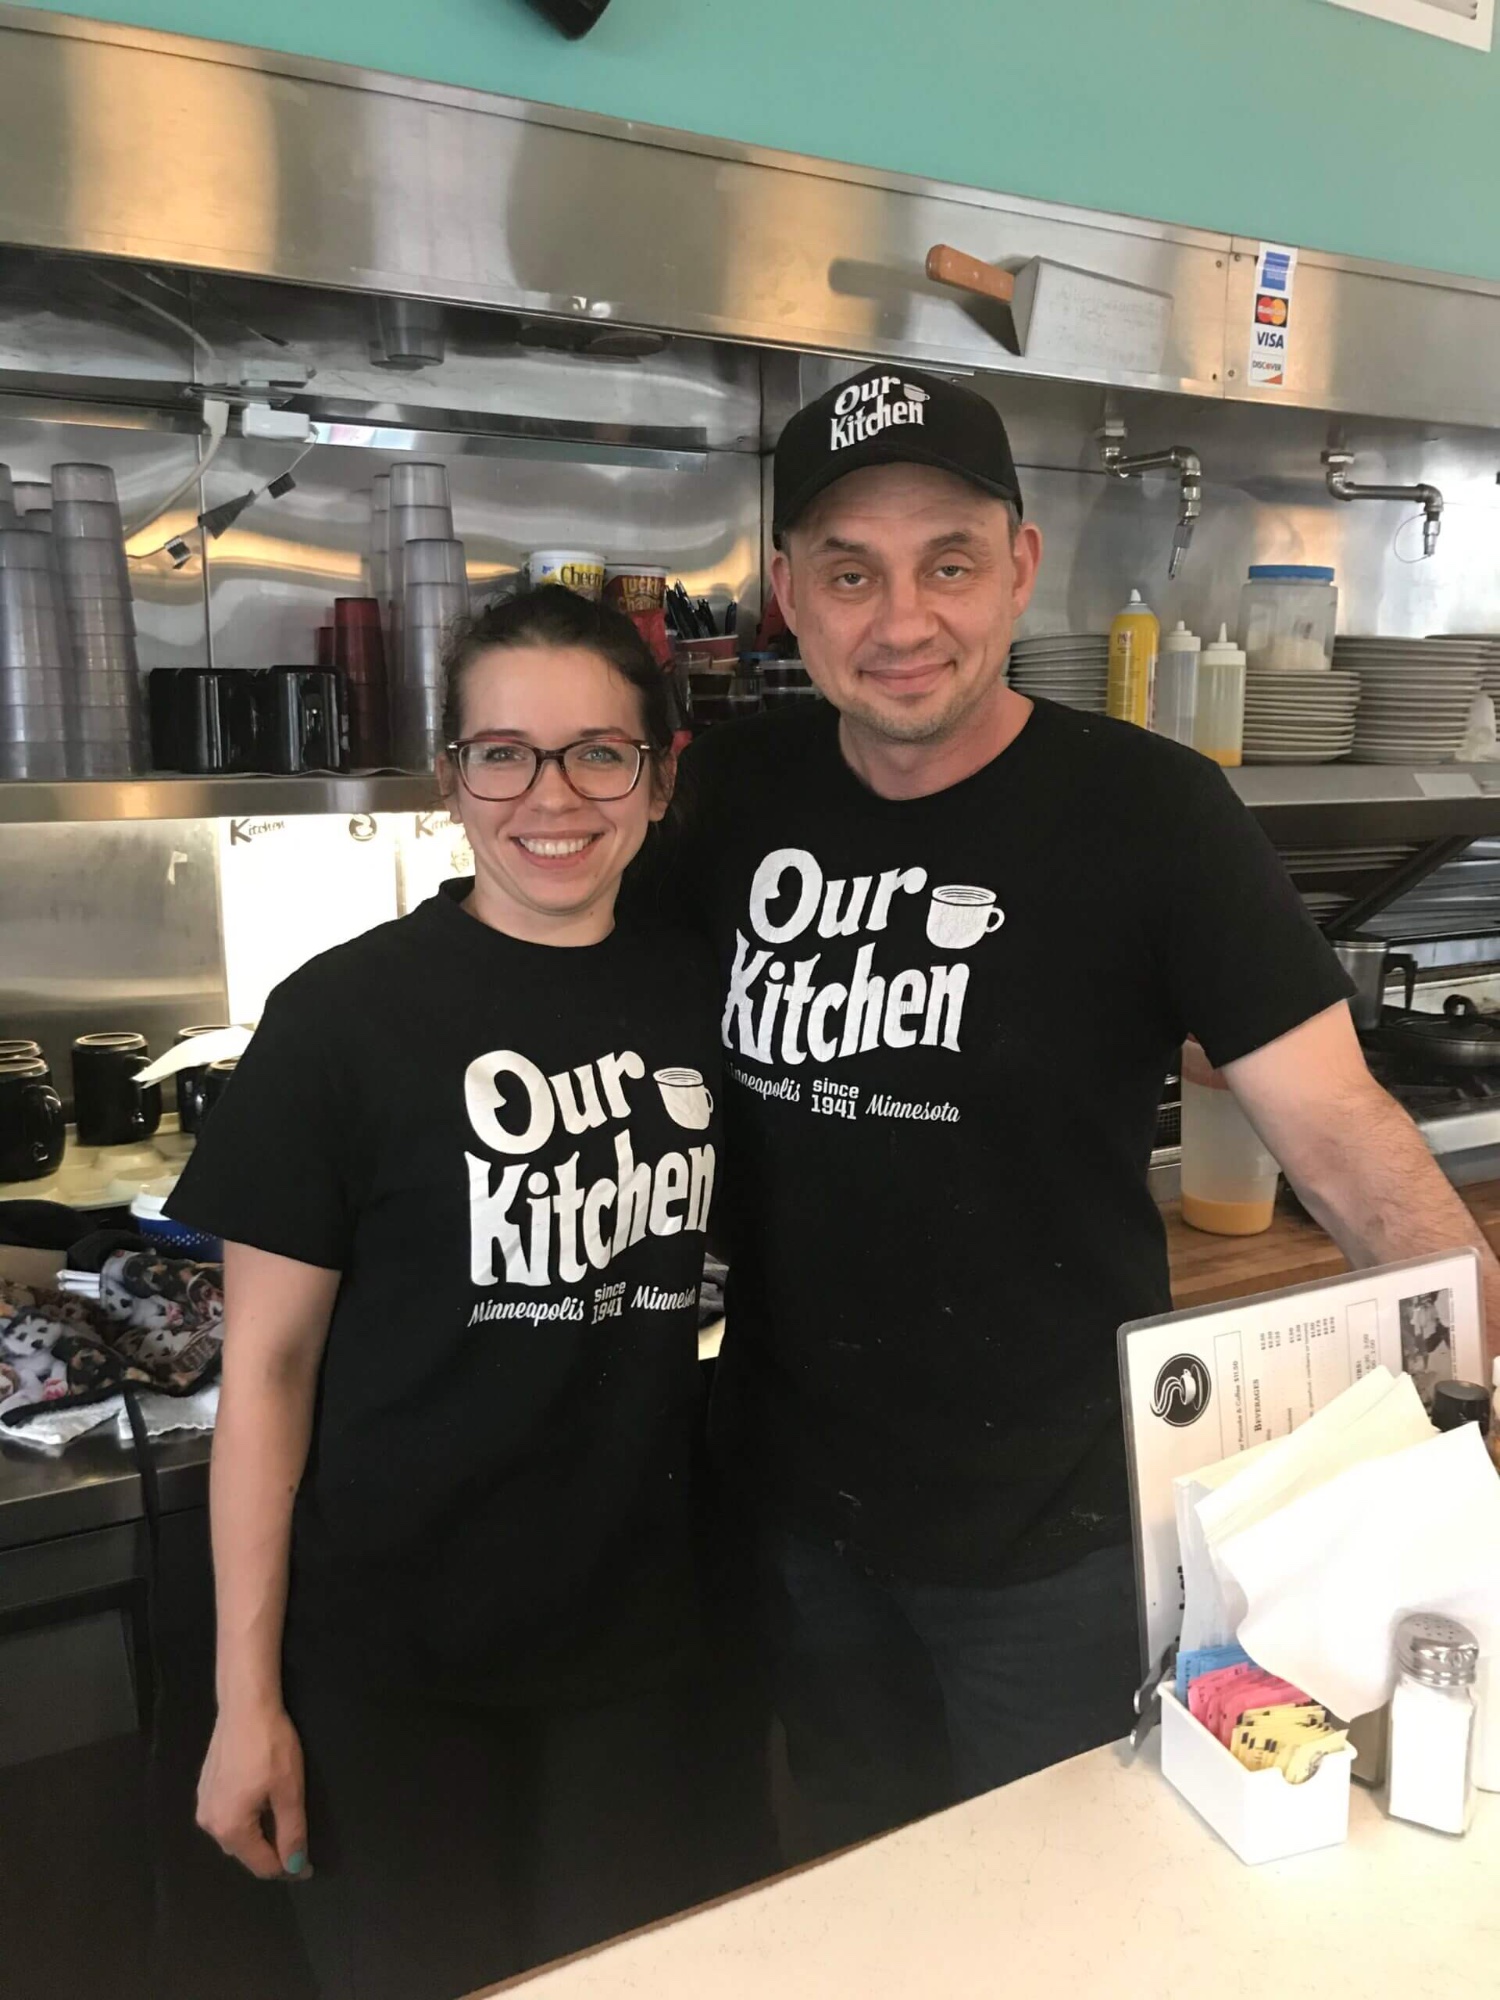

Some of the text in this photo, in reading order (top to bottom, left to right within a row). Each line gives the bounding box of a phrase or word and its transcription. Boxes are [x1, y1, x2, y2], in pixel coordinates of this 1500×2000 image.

[1257, 331, 1284, 348] VISA
[1252, 360, 1282, 371] DISCOVER
[835, 376, 901, 415] Our
[831, 394, 925, 451] Kitchen
[749, 848, 928, 944] Our
[721, 928, 970, 1065] Kitchen
[729, 1062, 801, 1102] inneapolis
[813, 1078, 860, 1099] since
[464, 1050, 645, 1155] Our
[811, 1095, 857, 1120] 1941
[865, 1094, 961, 1122] Minnesota
[464, 1129, 716, 1286] Kitchen
[594, 1281, 627, 1302] since
[467, 1297, 584, 1327] Minneapolis
[591, 1297, 623, 1325] 1941
[1253, 1378, 1262, 1432] BEVERAGES
